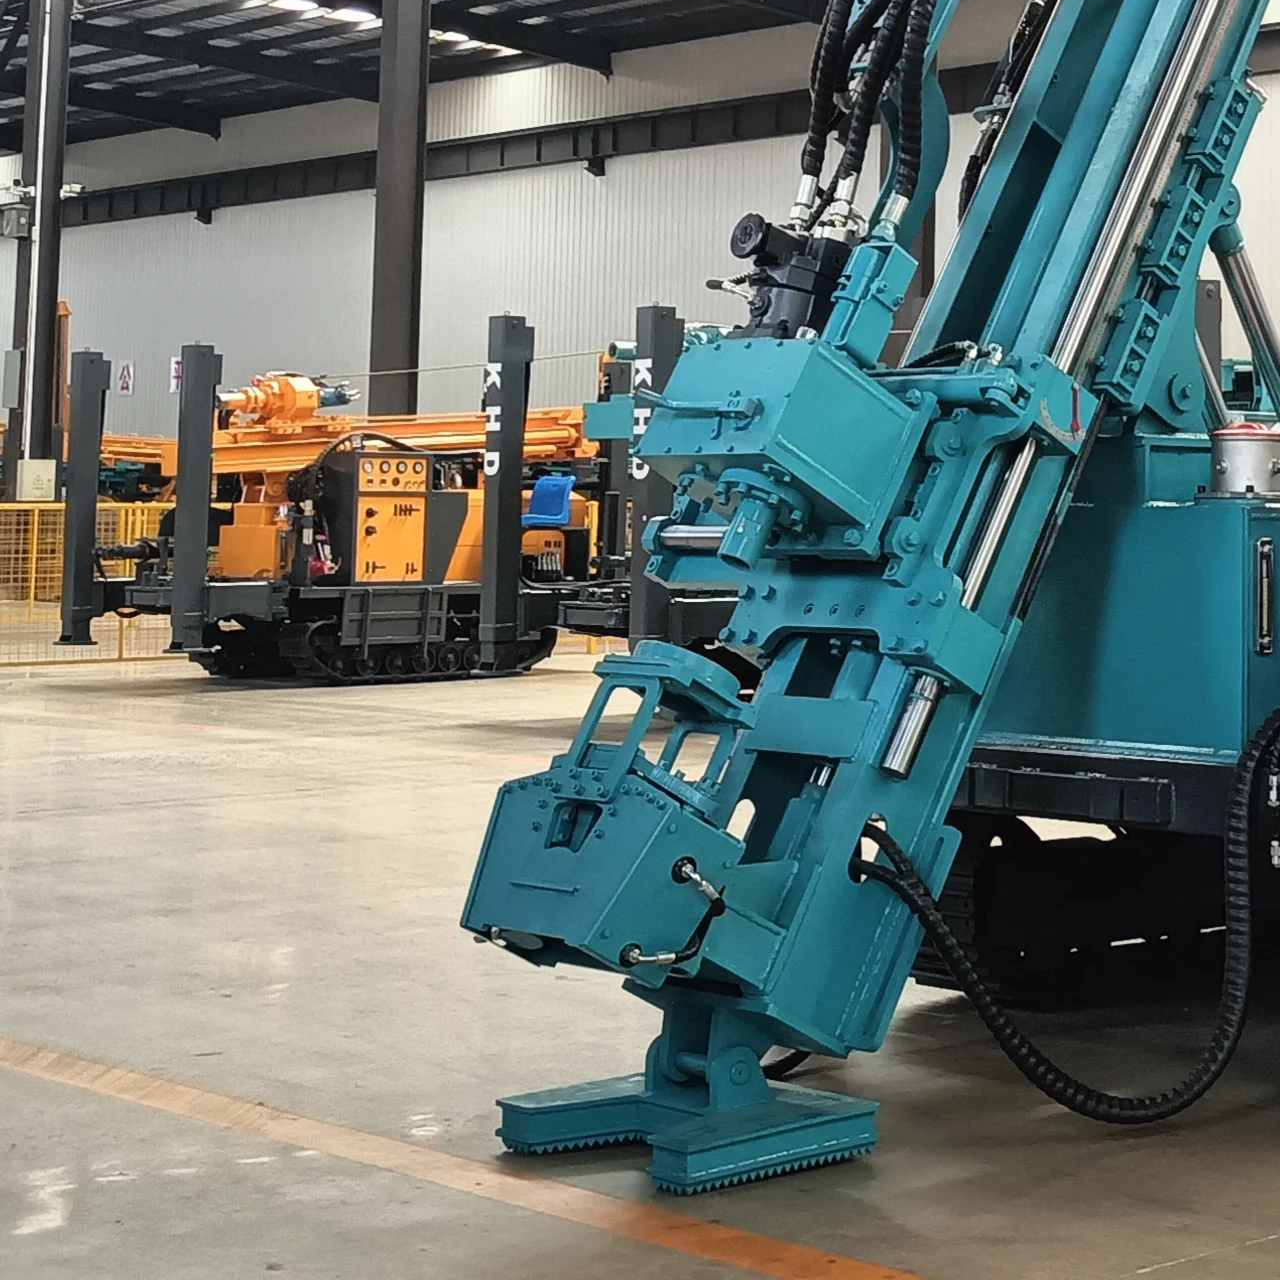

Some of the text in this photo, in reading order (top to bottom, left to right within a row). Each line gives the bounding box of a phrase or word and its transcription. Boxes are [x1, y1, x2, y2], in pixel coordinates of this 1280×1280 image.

[119, 363, 132, 392] 公
[484, 362, 502, 476] KHD
[632, 358, 653, 480] KHD
